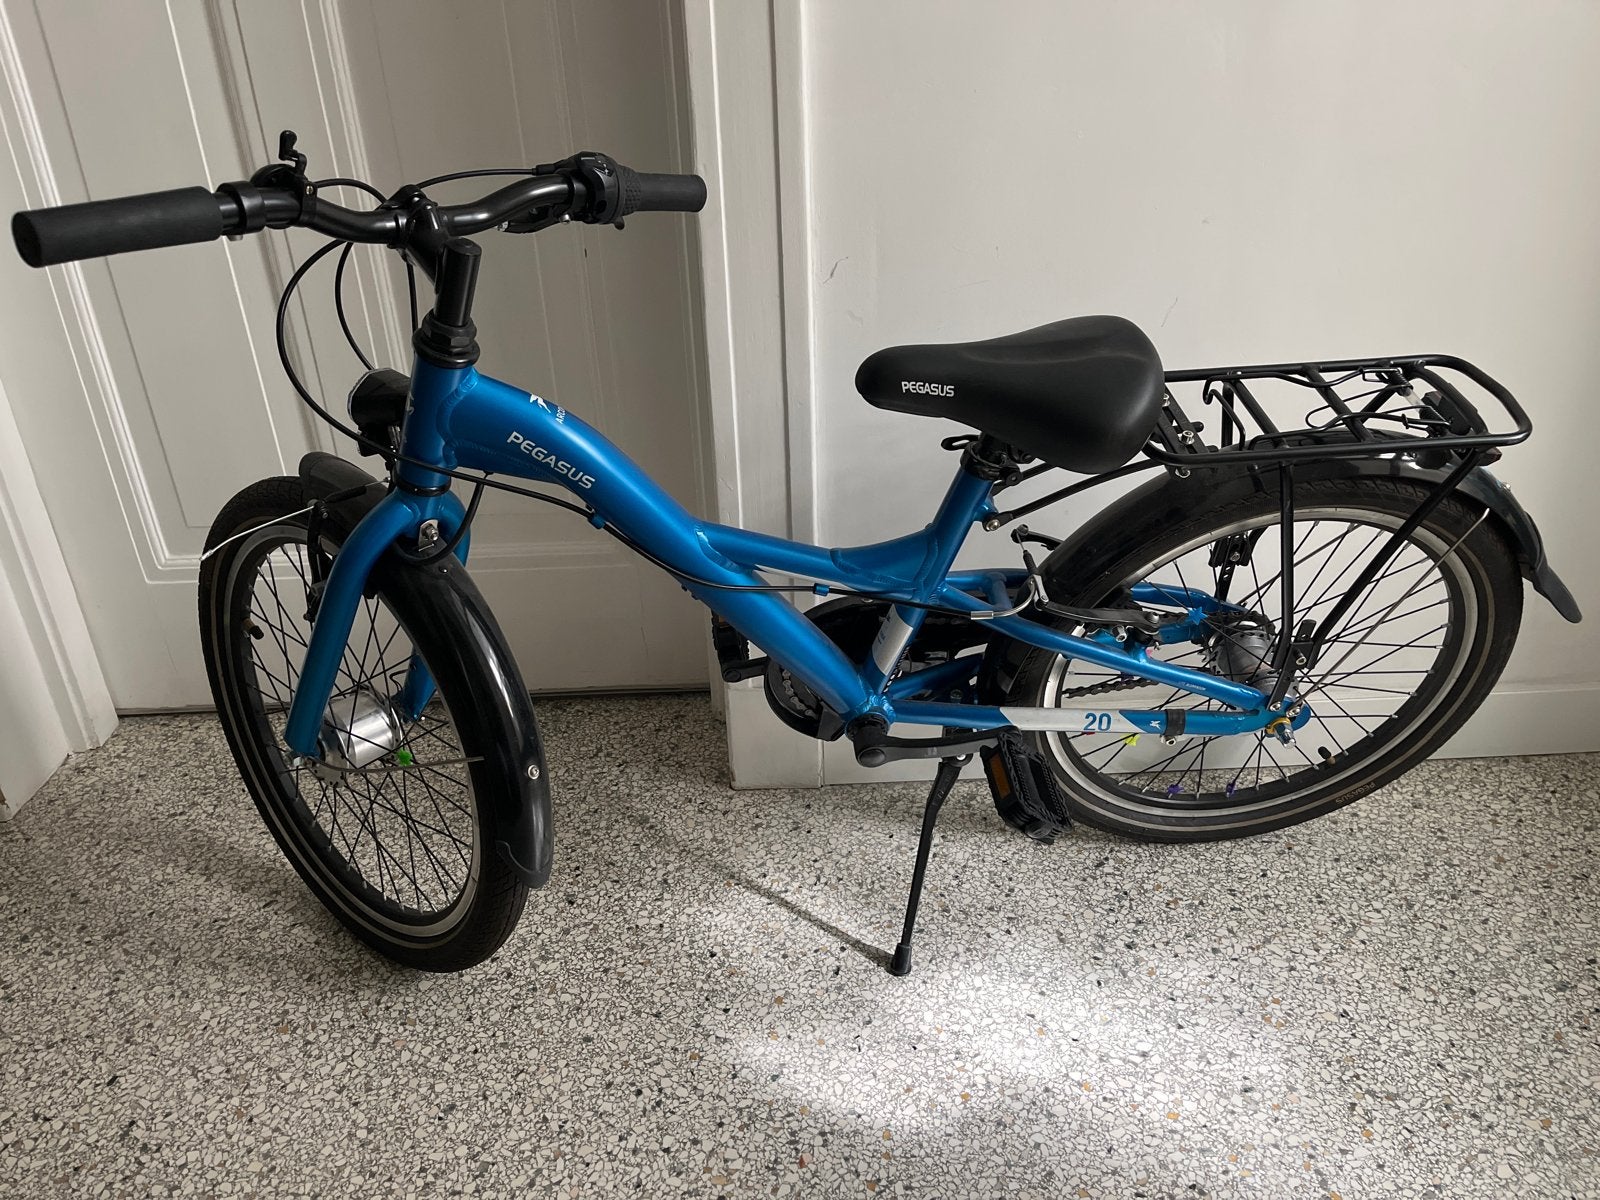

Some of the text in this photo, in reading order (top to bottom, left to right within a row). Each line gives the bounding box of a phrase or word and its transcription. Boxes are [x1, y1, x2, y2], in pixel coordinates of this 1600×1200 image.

[901, 381, 955, 397] PEGASUS
[506, 431, 596, 489] PEGASUS
[1083, 712, 1112, 731] 20
[1335, 781, 1376, 804] PEGASUS
